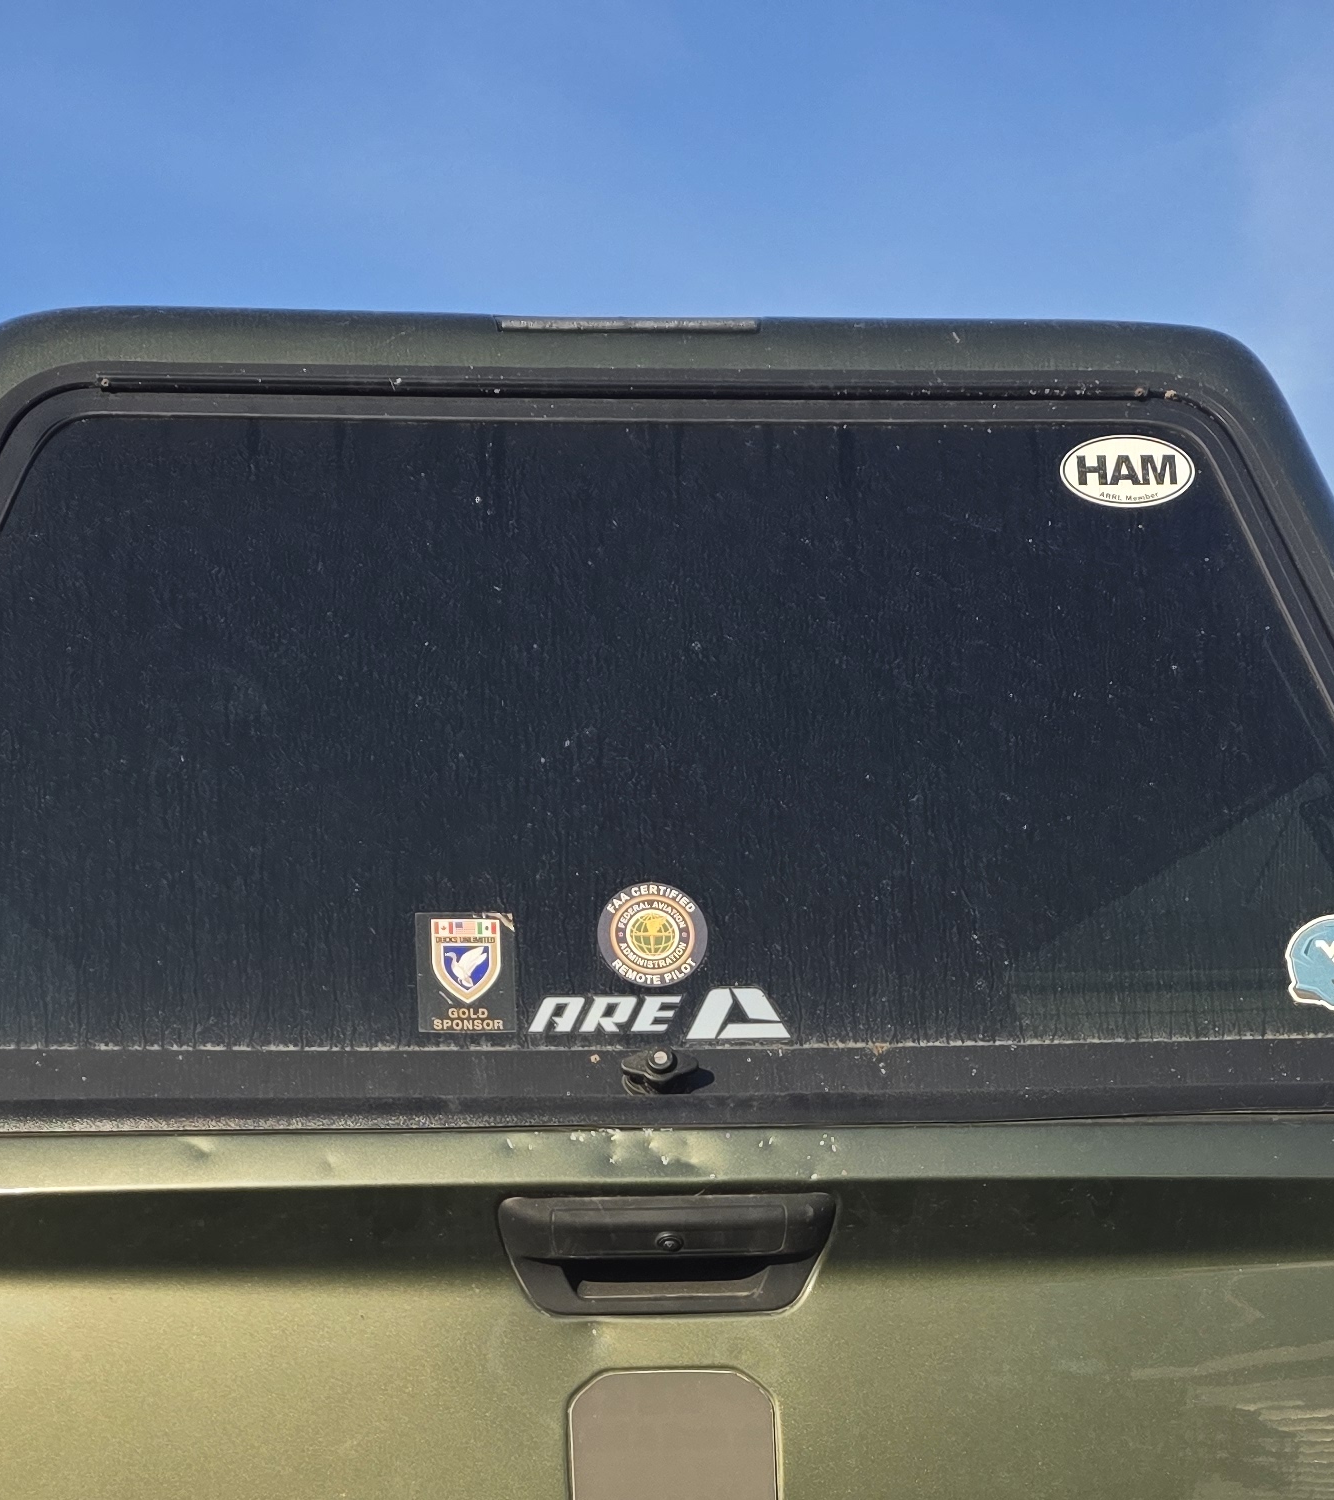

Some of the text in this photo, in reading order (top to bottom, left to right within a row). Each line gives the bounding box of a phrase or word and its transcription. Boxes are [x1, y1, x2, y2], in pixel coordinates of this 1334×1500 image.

[1076, 454, 1178, 486] HAM
[1126, 491, 1159, 501] Member
[607, 884, 696, 914] FAA CERTIFIED
[618, 901, 686, 929] FEDERAL AVIATION
[619, 941, 687, 969] ADMINISTRATION
[612, 957, 696, 985] REMOTE PILOT
[433, 1019, 504, 1031] SPONSOR
[448, 1007, 488, 1019] GOLD
[527, 993, 682, 1034] ARE
